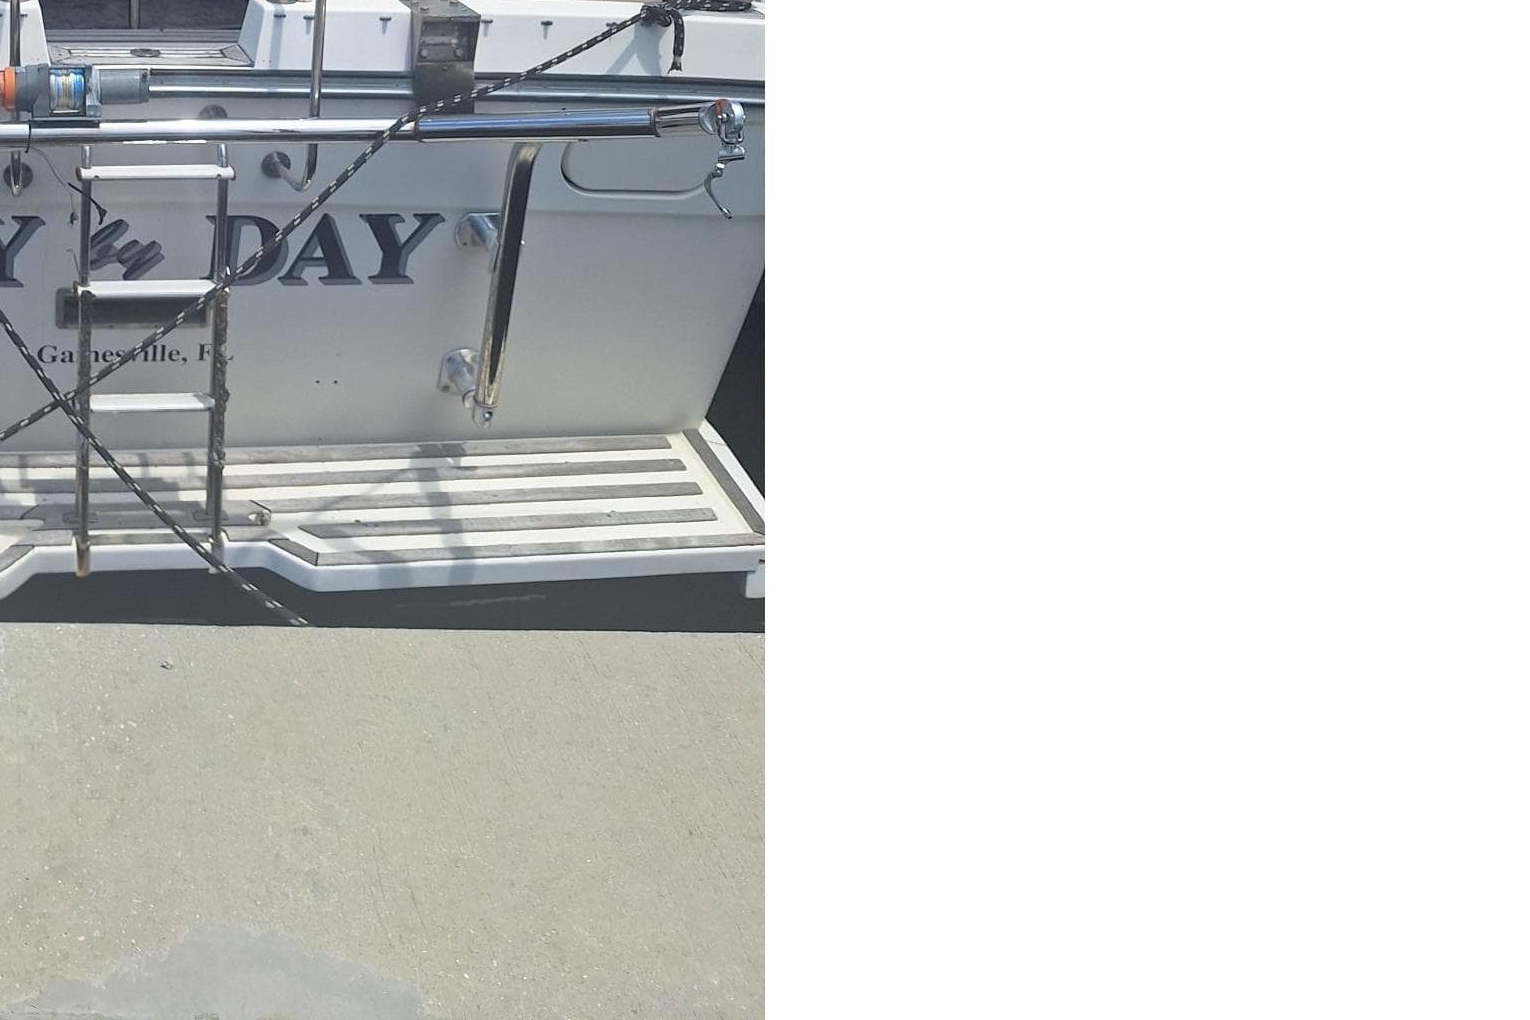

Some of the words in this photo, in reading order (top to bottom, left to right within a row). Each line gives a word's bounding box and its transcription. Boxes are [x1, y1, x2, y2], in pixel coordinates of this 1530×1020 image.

[87, 218, 166, 281] by
[199, 213, 446, 286] DAY
[36, 344, 188, 365] Ganesille,
[197, 343, 234, 362] F
